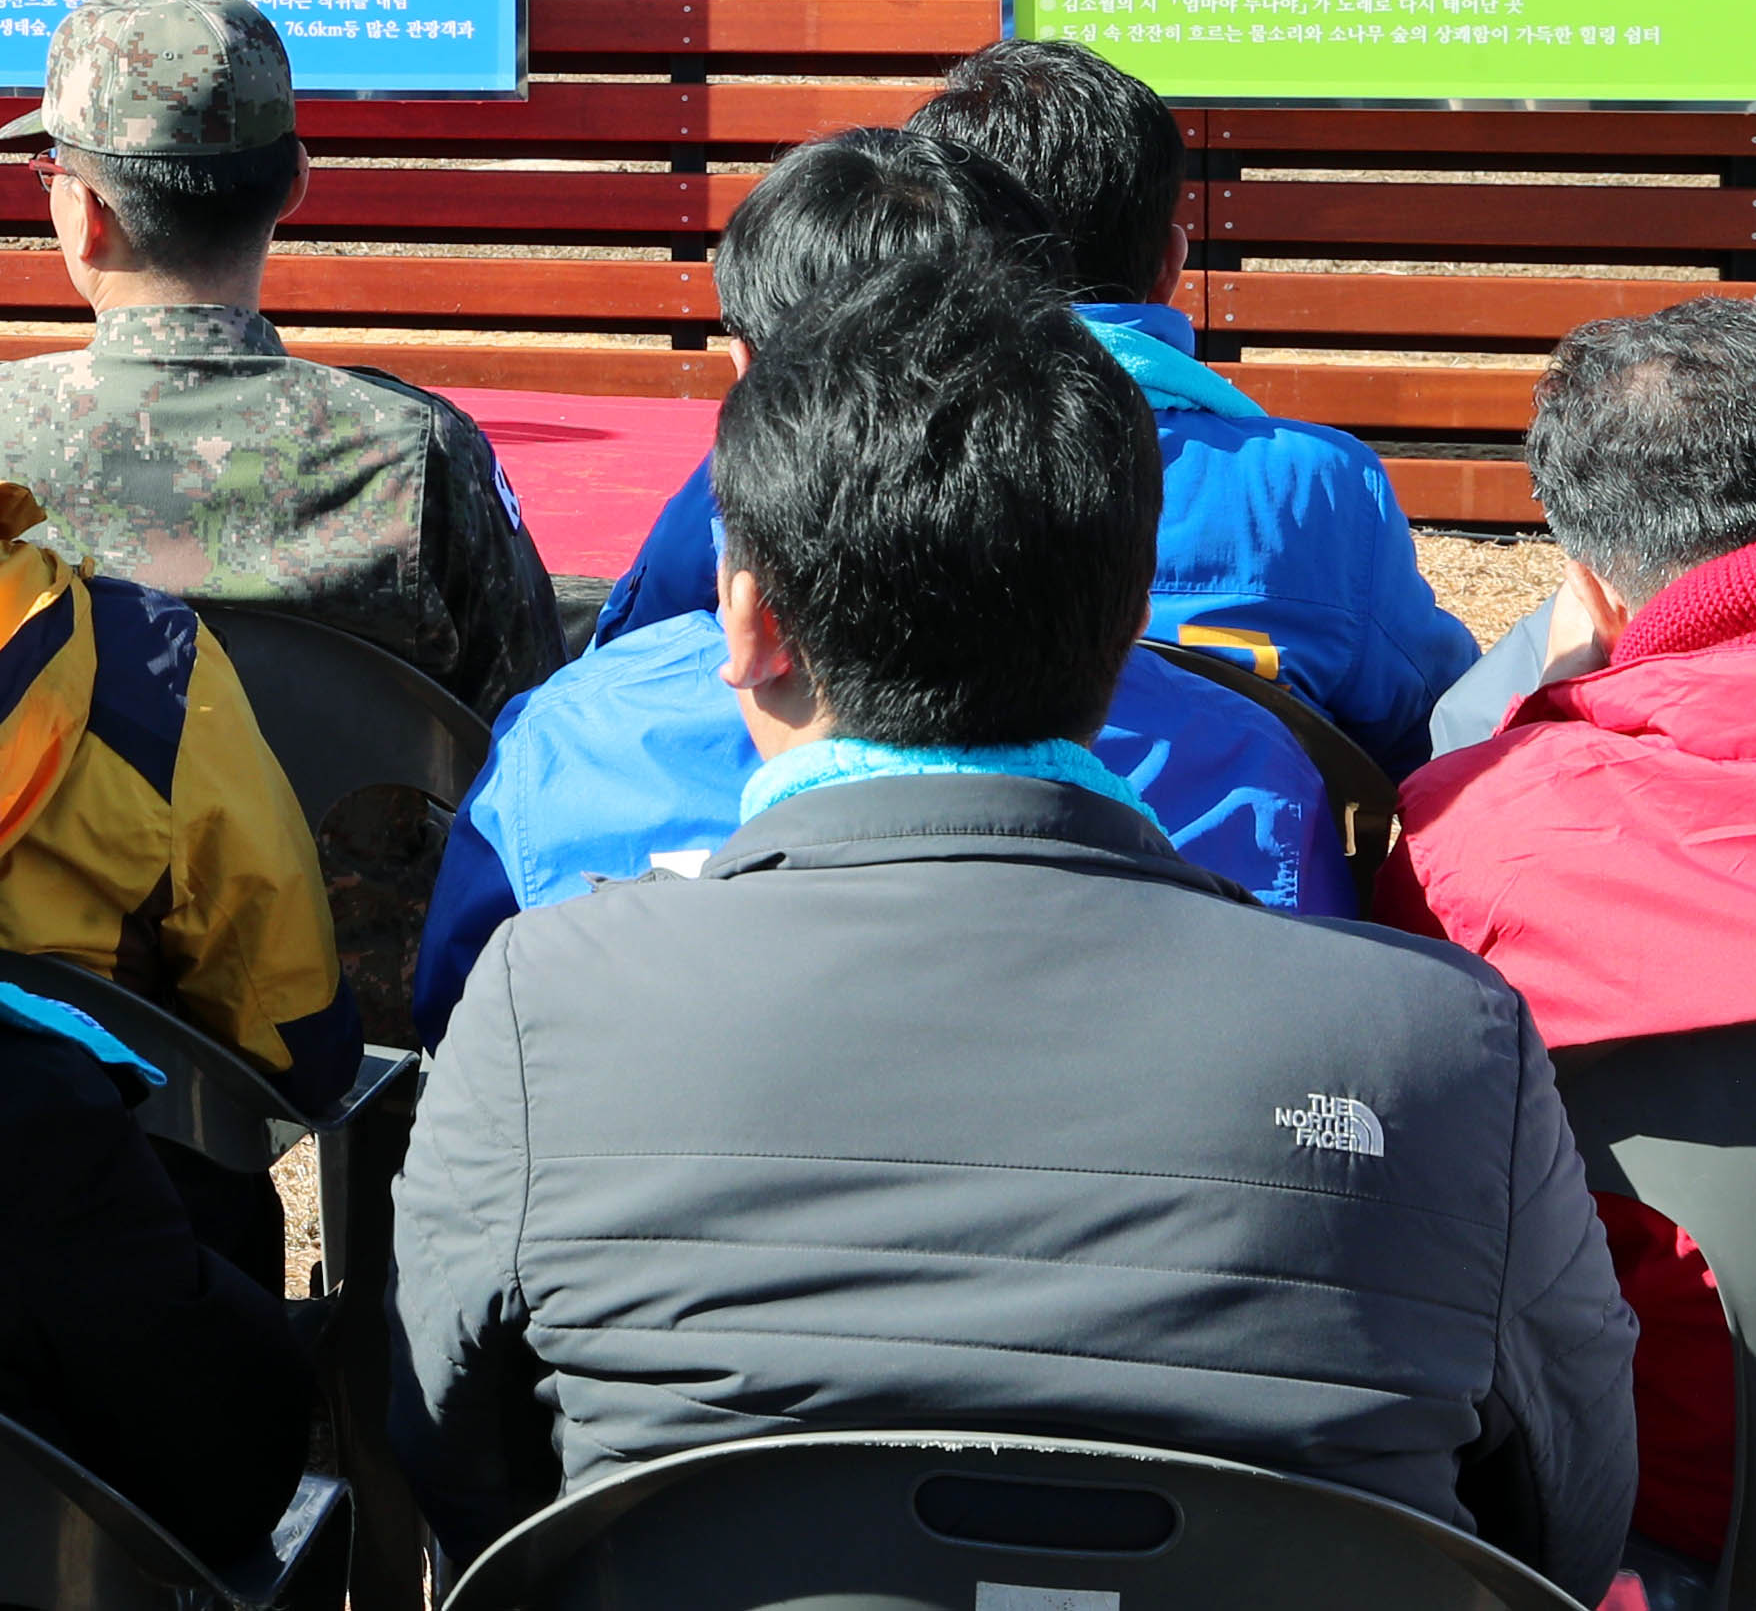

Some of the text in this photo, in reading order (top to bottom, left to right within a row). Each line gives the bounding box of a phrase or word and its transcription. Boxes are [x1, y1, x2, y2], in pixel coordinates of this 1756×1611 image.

[285, 20, 360, 39] 76.6km등
[366, 21, 400, 39] 많은
[406, 21, 476, 40] 관광객과
[1062, 23, 1661, 46] 도심 속 잔잔히 흐르는 물소리와 소나무 숲의 상쾌함이 가득한 힐링 쉼터
[1307, 1093, 1350, 1111] THE
[1274, 1106, 1353, 1134] NORTH
[1296, 1128, 1352, 1151] FACE
